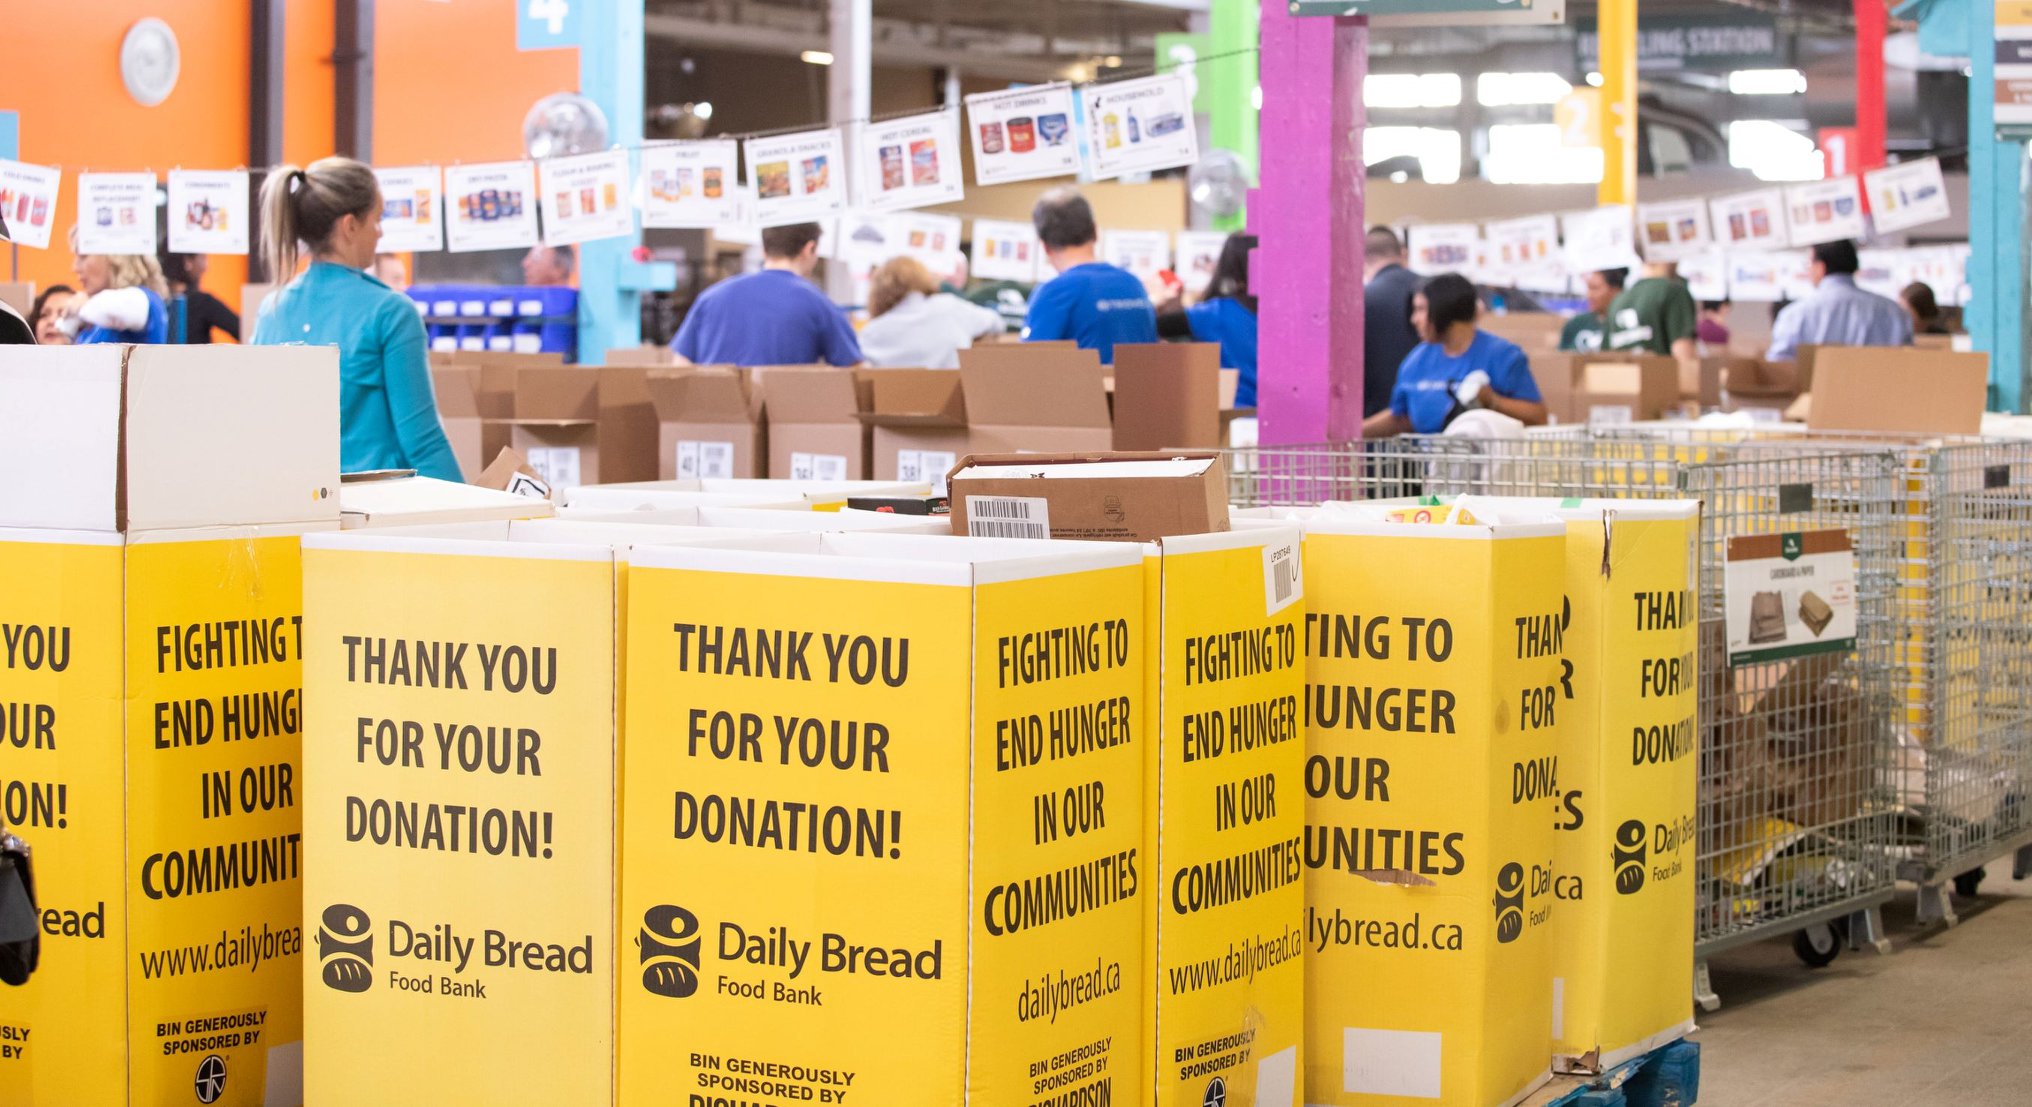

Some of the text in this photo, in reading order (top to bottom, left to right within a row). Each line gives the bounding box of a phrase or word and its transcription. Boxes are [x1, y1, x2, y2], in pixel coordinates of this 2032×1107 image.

[528, 0, 569, 34] 4
[1561, 99, 1590, 145] 2
[1824, 134, 1847, 177] 1
[2, 623, 71, 672] YOU
[157, 617, 286, 673] FIGHTING
[342, 635, 557, 695] THANK YOU
[673, 623, 909, 688] THANK YOU
[998, 618, 1128, 688] FIGHTING TO
[1185, 622, 1295, 686] FIGHTING TO
[1401, 617, 1453, 663] TO
[1641, 657, 1680, 698] FOR
[0, 702, 57, 751] UR
[154, 688, 302, 750] END HUNG
[996, 695, 1131, 772] END HUNGER
[1183, 694, 1297, 763] END HUNGER
[1305, 684, 1456, 735] UNGER
[1520, 686, 1555, 731] FOR
[357, 716, 542, 777] FOR YOUR
[688, 708, 890, 773] FOR YOUR
[202, 762, 294, 819] IN OUR
[1216, 772, 1276, 832] IN OUR
[1304, 754, 1391, 802] OUR
[0, 779, 67, 829] ON!
[346, 796, 553, 860] DONATION!
[673, 791, 902, 860] DONATION!
[1034, 780, 1105, 846] IN OUR
[984, 848, 1138, 937] COMMUNITIES
[1172, 838, 1301, 915] COMMUNITIES
[37, 901, 105, 938] ead
[389, 920, 592, 974] Daily Bread
[718, 922, 942, 980] Daily Bread
[1169, 923, 1302, 995] www.dailybread.ca
[390, 971, 487, 999] Food Bank
[717, 976, 823, 1006] Food Bank
[1018, 956, 1121, 1025] dailybread.ca
[157, 1011, 267, 1037] BIN GENEROUSLY
[163, 1031, 260, 1055] SPONSORED BY
[1175, 1028, 1256, 1063] BIN GENEROUSLY
[2, 1044, 23, 1060] BY
[690, 1053, 856, 1086] BIN GENEROUSLY
[1029, 1036, 1112, 1078] BIN GENEROUSLY
[1034, 1062, 1094, 1095] SPONSORED
[1096, 1056, 1108, 1073] BY
[1180, 1047, 1251, 1081] SPONSORED BY
[697, 1073, 814, 1101] SPONSORED
[820, 1089, 846, 1104] BY
